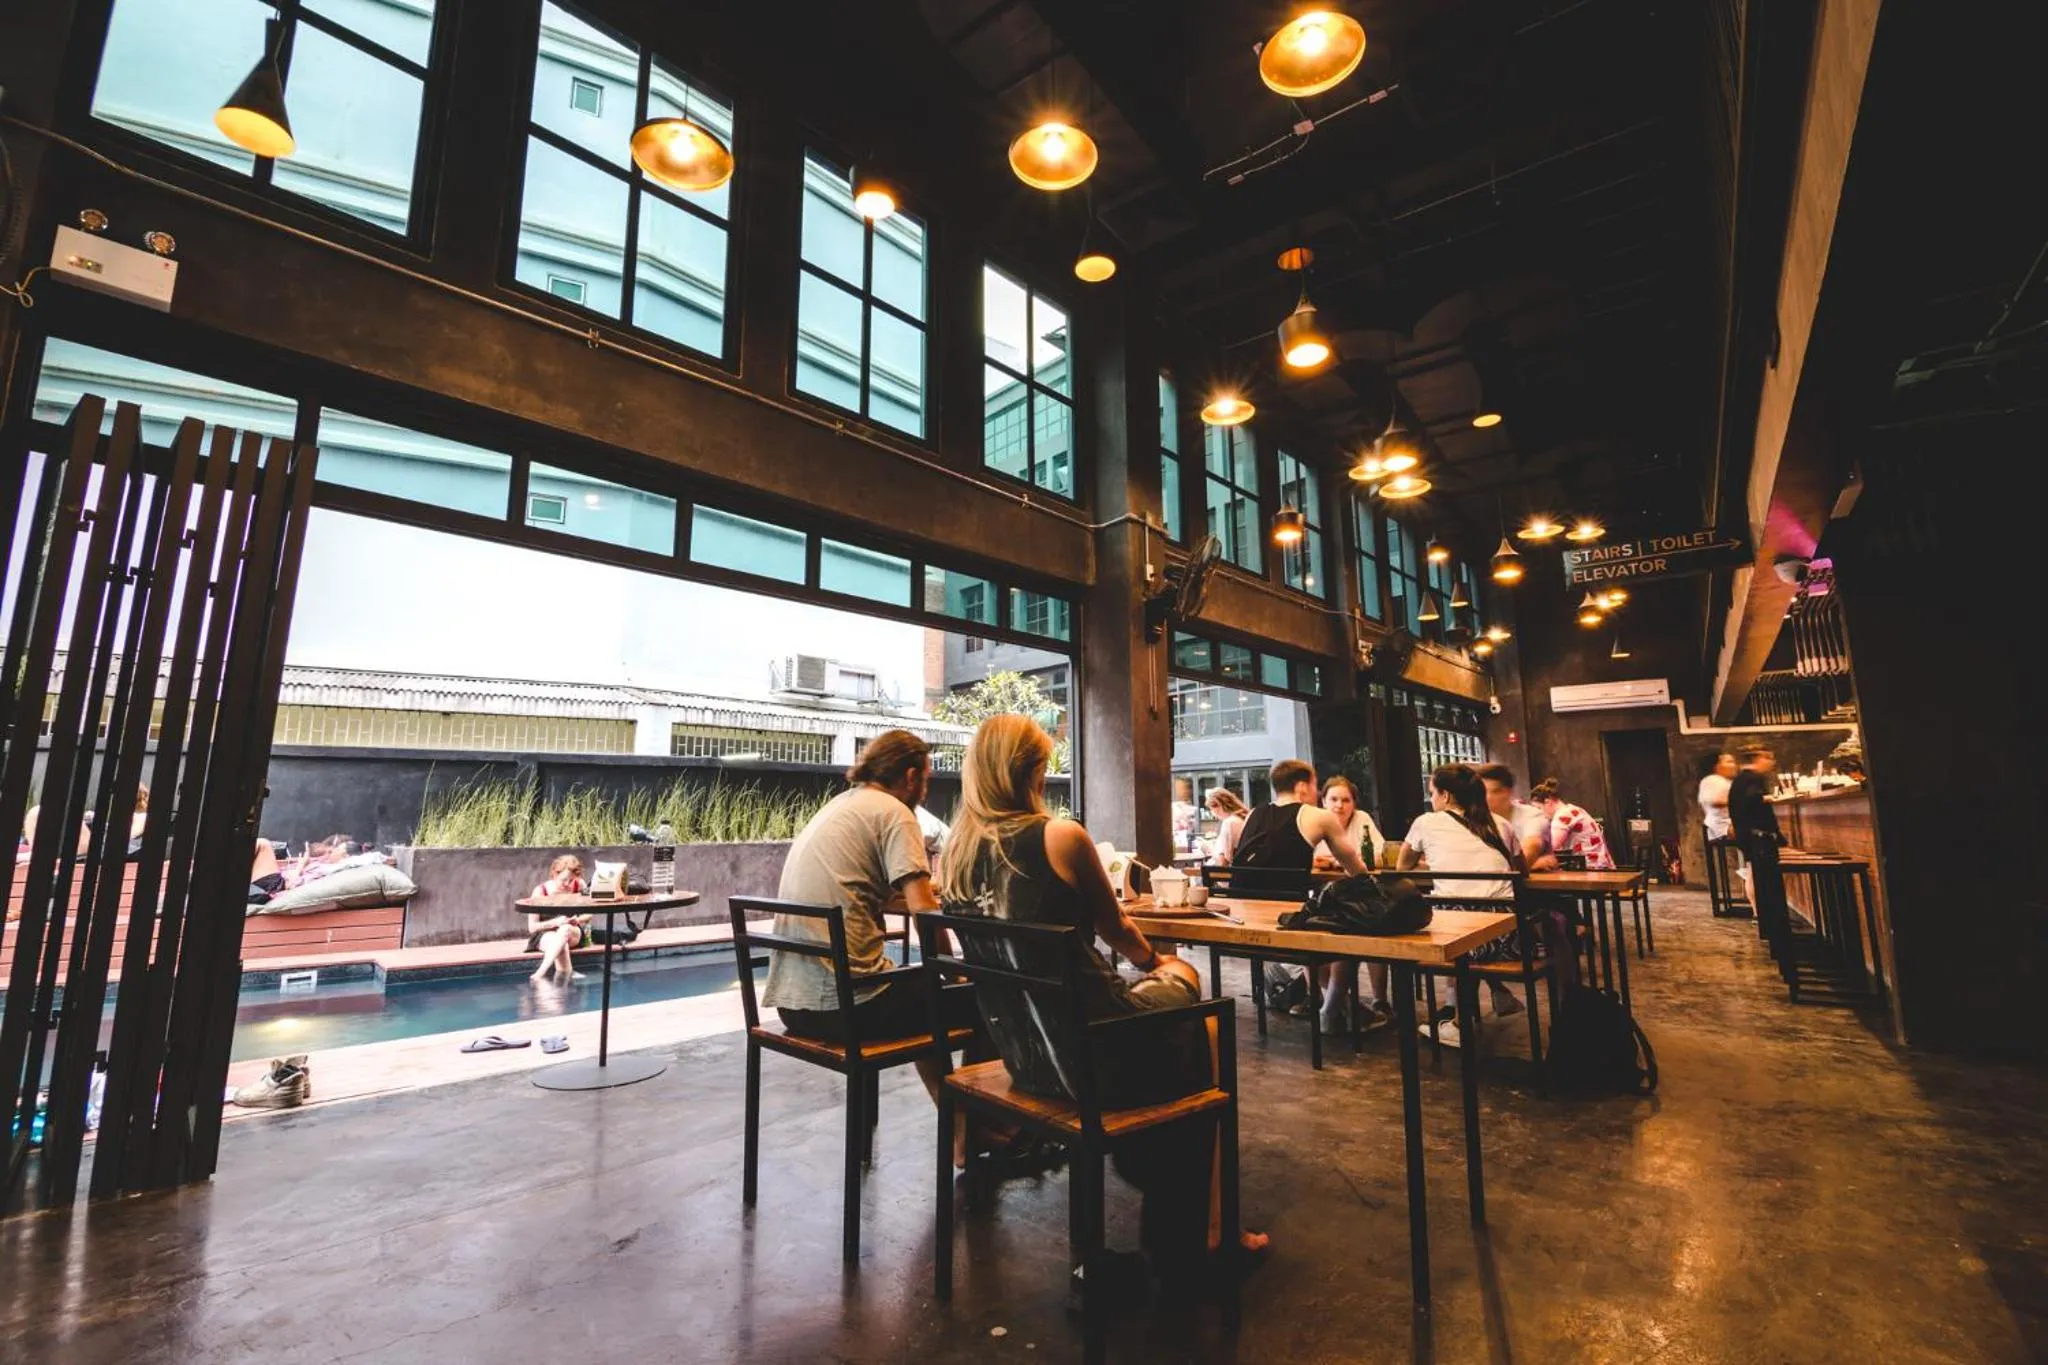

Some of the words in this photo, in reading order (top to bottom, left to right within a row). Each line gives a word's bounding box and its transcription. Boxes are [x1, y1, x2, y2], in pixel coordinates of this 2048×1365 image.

[1571, 543, 1633, 564] STAIRS
[1649, 530, 1716, 552] TOILET
[1573, 559, 1667, 583] ELEVATOR
